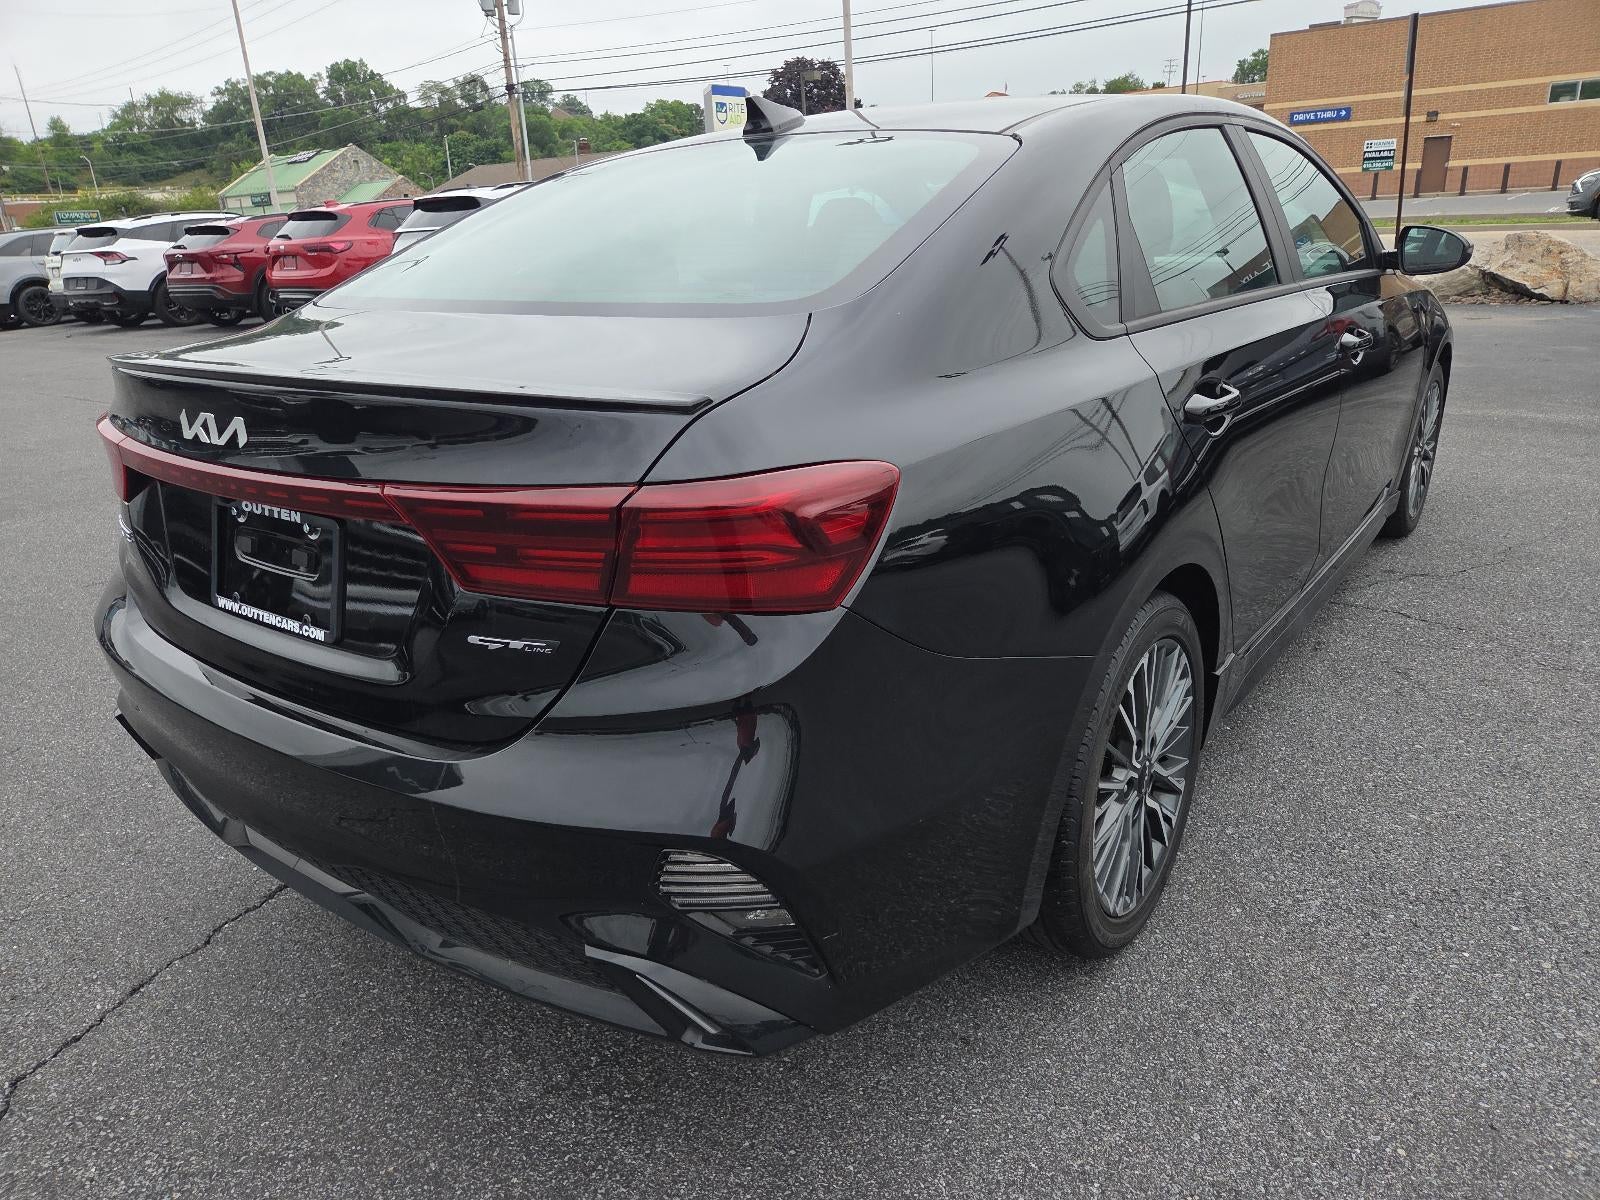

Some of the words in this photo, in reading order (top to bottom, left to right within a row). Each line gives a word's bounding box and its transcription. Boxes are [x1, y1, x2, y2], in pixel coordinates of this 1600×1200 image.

[728, 102, 745, 114] RITE
[728, 114, 742, 125] AID
[1293, 112, 1316, 121] DRIVE
[1316, 110, 1338, 119] THRU
[1364, 150, 1395, 158] AVAILABLE
[58, 212, 90, 220] TOMPKINS
[180, 408, 248, 449] KIA
[241, 500, 301, 524] OUTTEN
[216, 595, 326, 642] WWW.OUTTENCARS.COM
[525, 646, 553, 654] LINE
